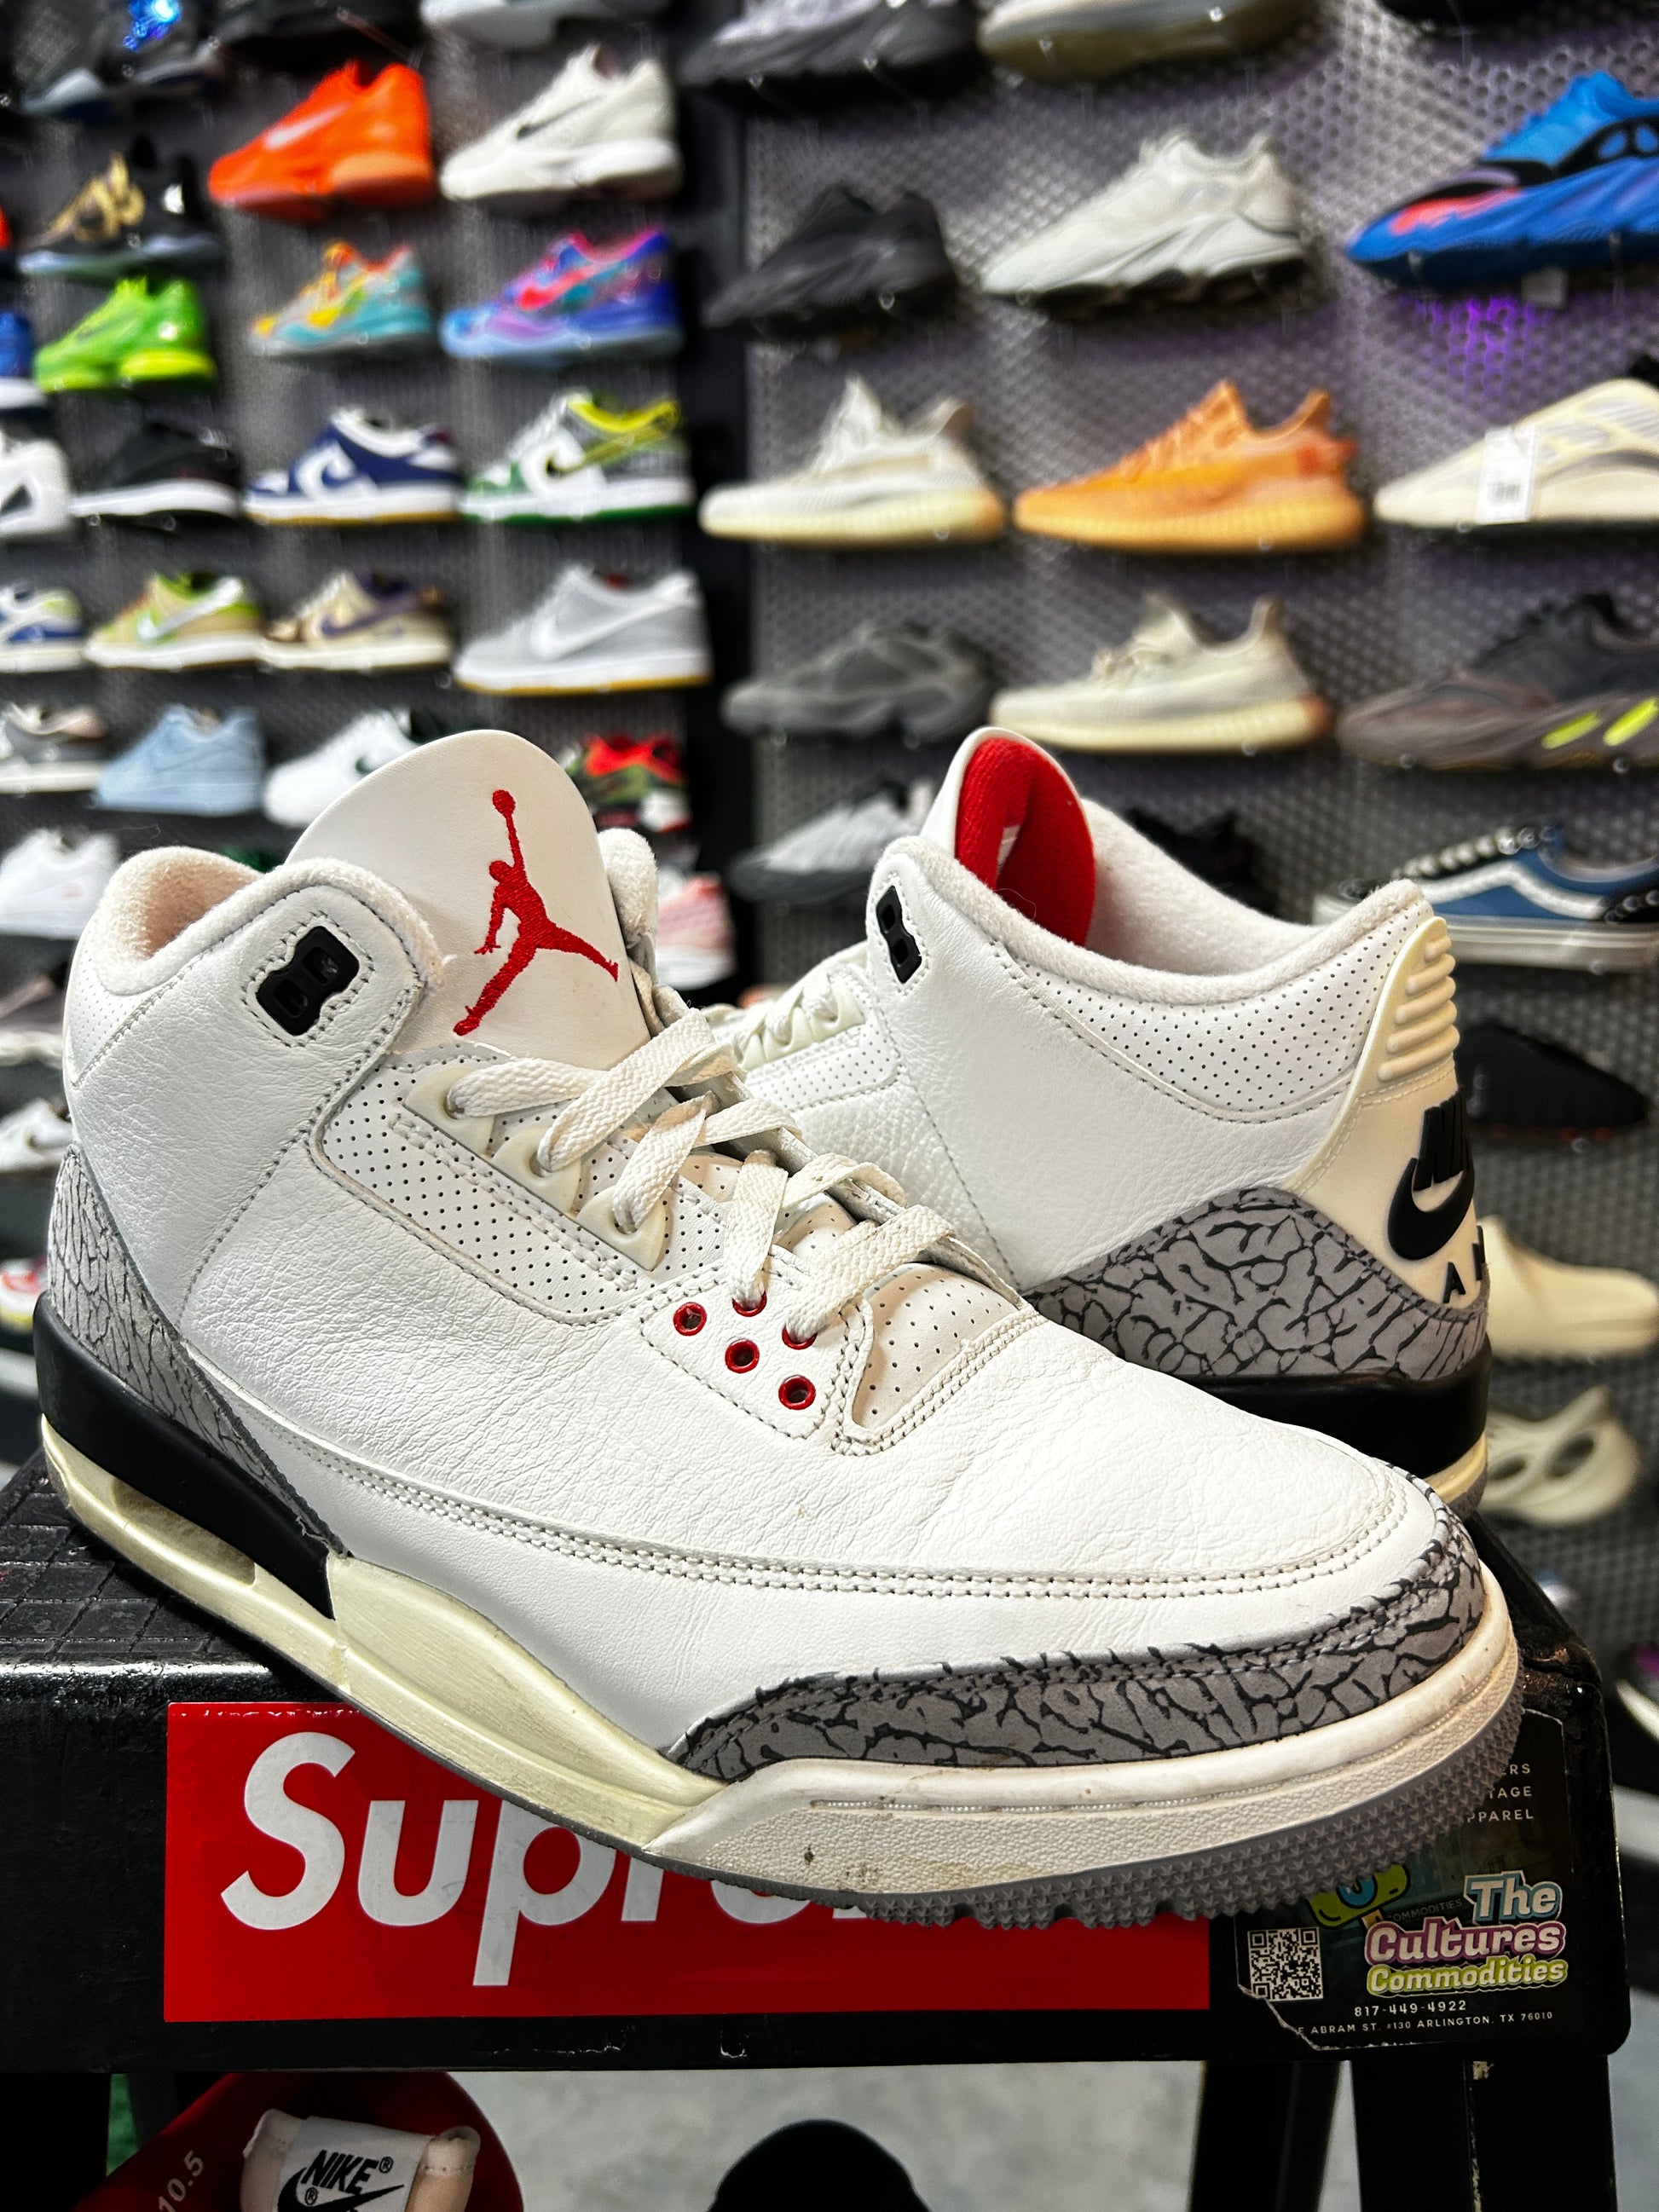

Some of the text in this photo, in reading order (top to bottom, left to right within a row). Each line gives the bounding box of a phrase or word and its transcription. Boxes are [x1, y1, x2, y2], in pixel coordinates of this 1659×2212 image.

[1467, 1808, 1534, 1823] PPAREL
[1388, 1898, 1463, 1922] OMMODITIES
[1467, 1874, 1559, 1920] The
[1368, 1920, 1564, 1963] Cultures
[1369, 1957, 1566, 1994] Commodities
[1310, 2024, 1356, 2035] ABRAM
[1500, 2013, 1515, 2023] TX
[1521, 2012, 1553, 2022] 76010
[1354, 2000, 1466, 2017] 817-449-4922
[158, 2149, 204, 2212] 10.5
